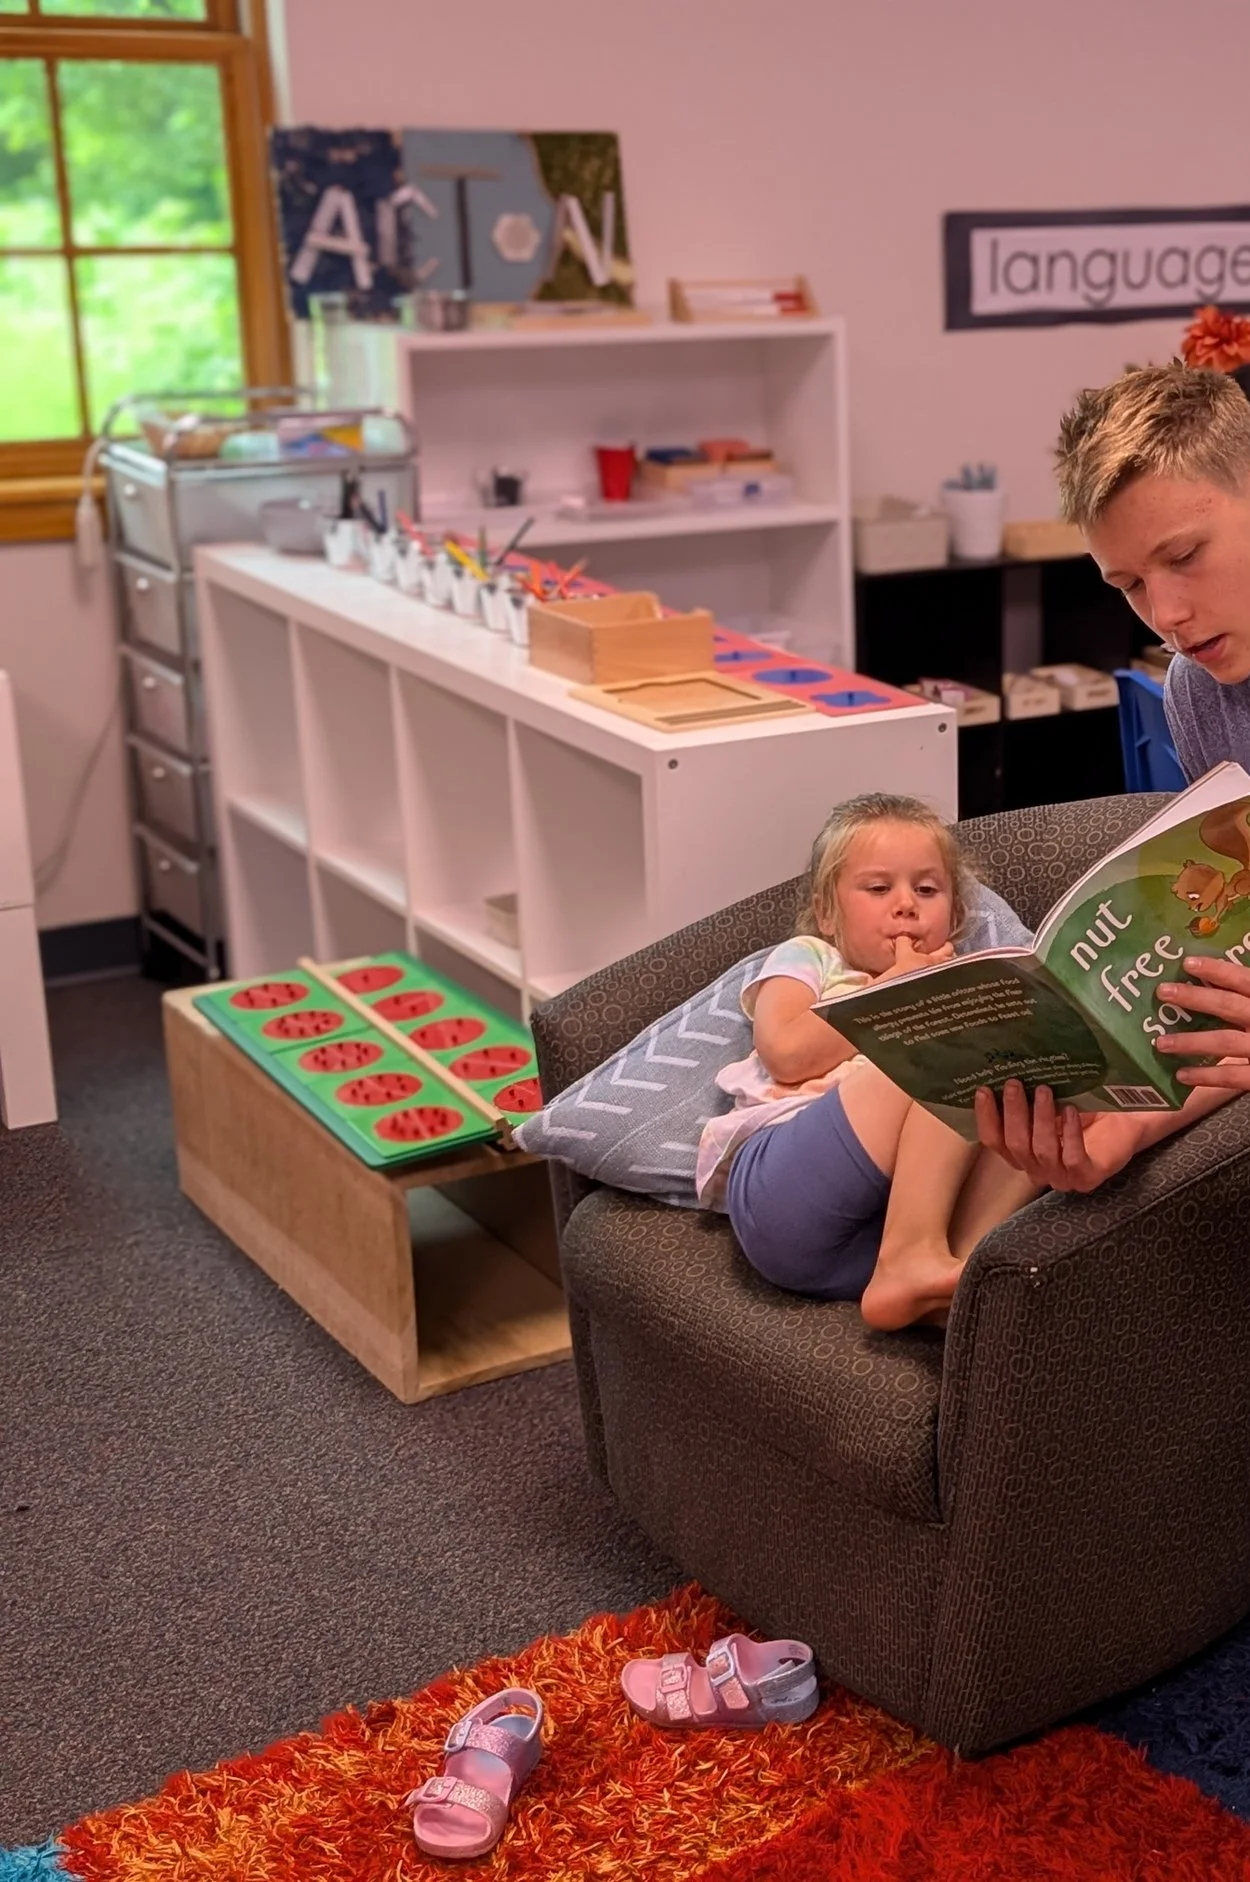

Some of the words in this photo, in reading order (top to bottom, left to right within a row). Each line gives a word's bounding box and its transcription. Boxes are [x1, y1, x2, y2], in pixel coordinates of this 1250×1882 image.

[290, 164, 615, 291] ACTON
[1070, 899, 1132, 972] nut
[1100, 935, 1184, 1012] free
